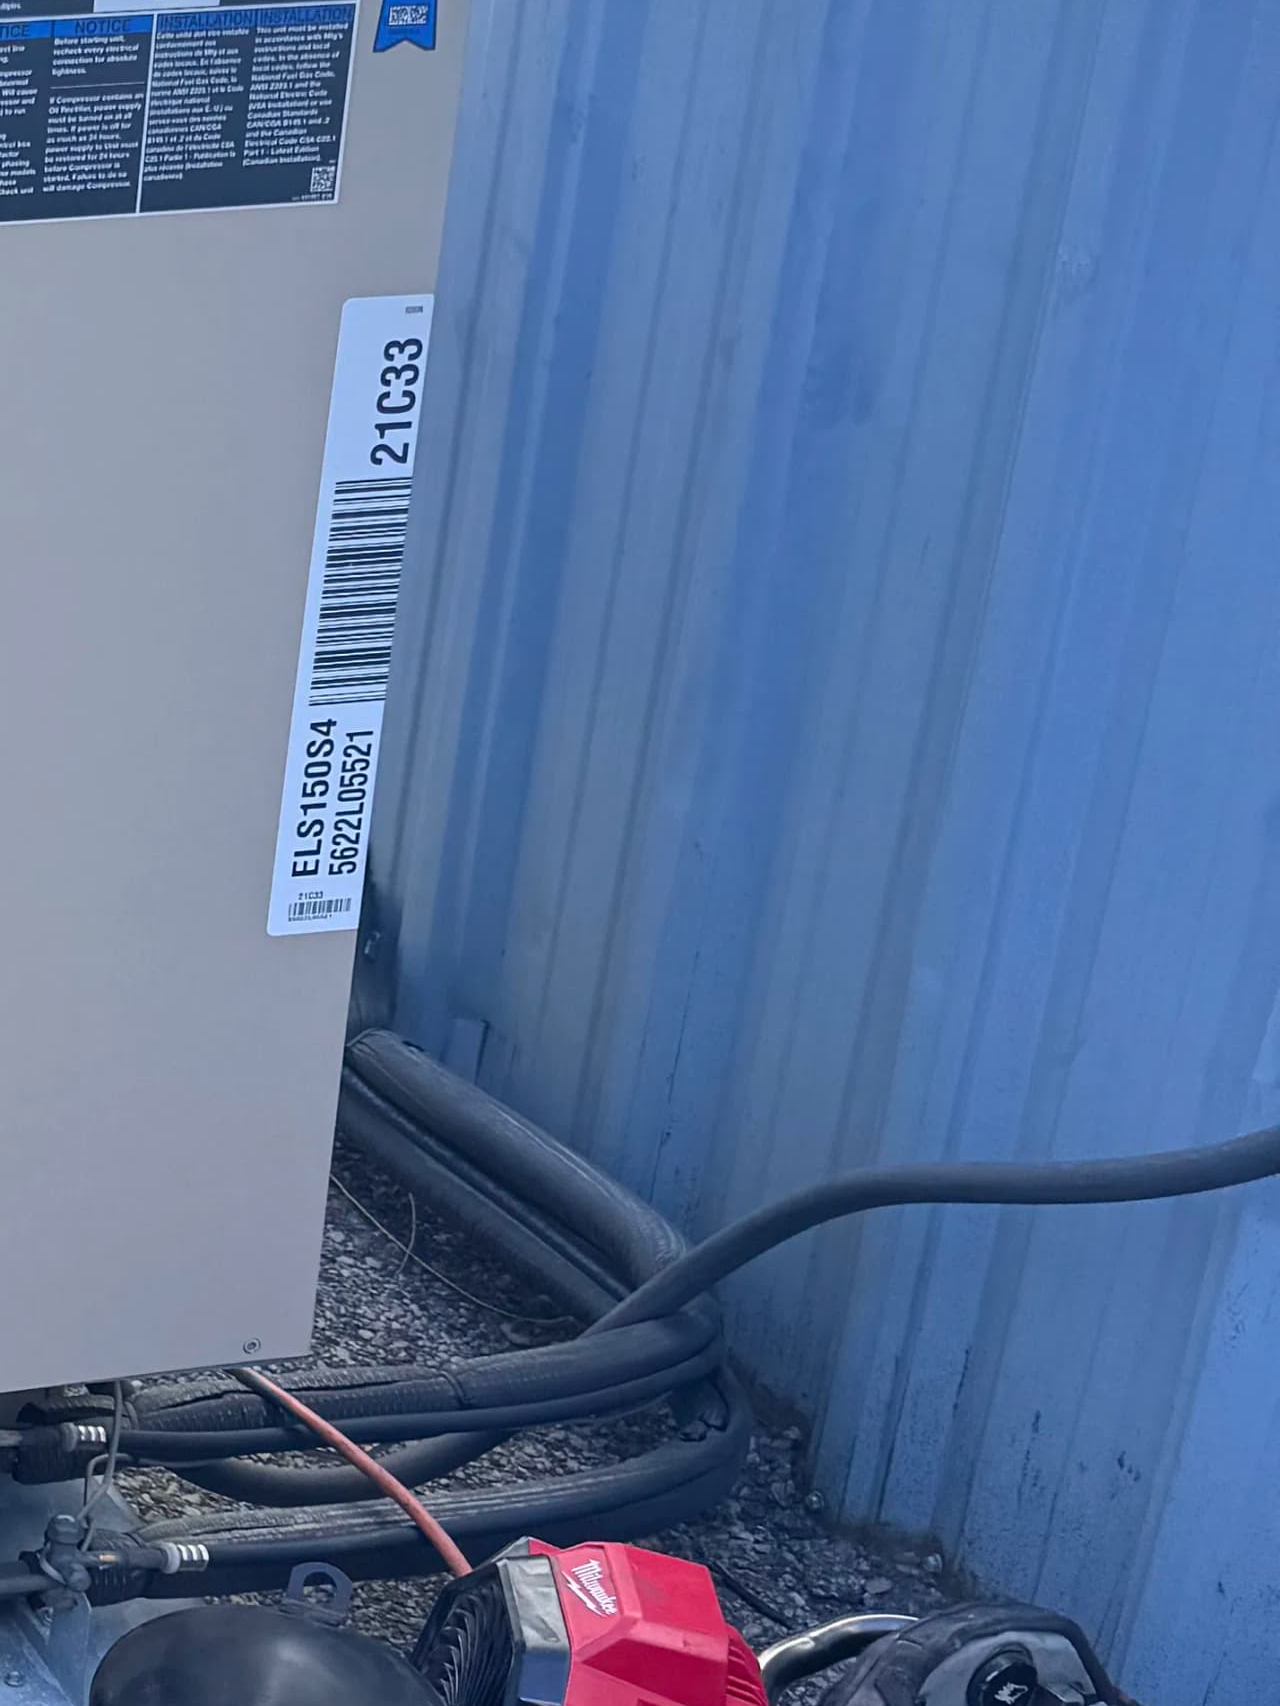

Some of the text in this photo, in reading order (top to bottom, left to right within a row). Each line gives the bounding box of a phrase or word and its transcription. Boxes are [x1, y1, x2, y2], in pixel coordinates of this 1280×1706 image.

[74, 18, 129, 34] NOTICE
[159, 11, 253, 30] INSTALLATION
[259, 5, 352, 24] INSTALLATION
[370, 338, 423, 466] 21C33
[291, 718, 337, 877] ELS150S4
[328, 731, 374, 875] 5622L05521
[571, 1559, 617, 1615] Milwaukee
